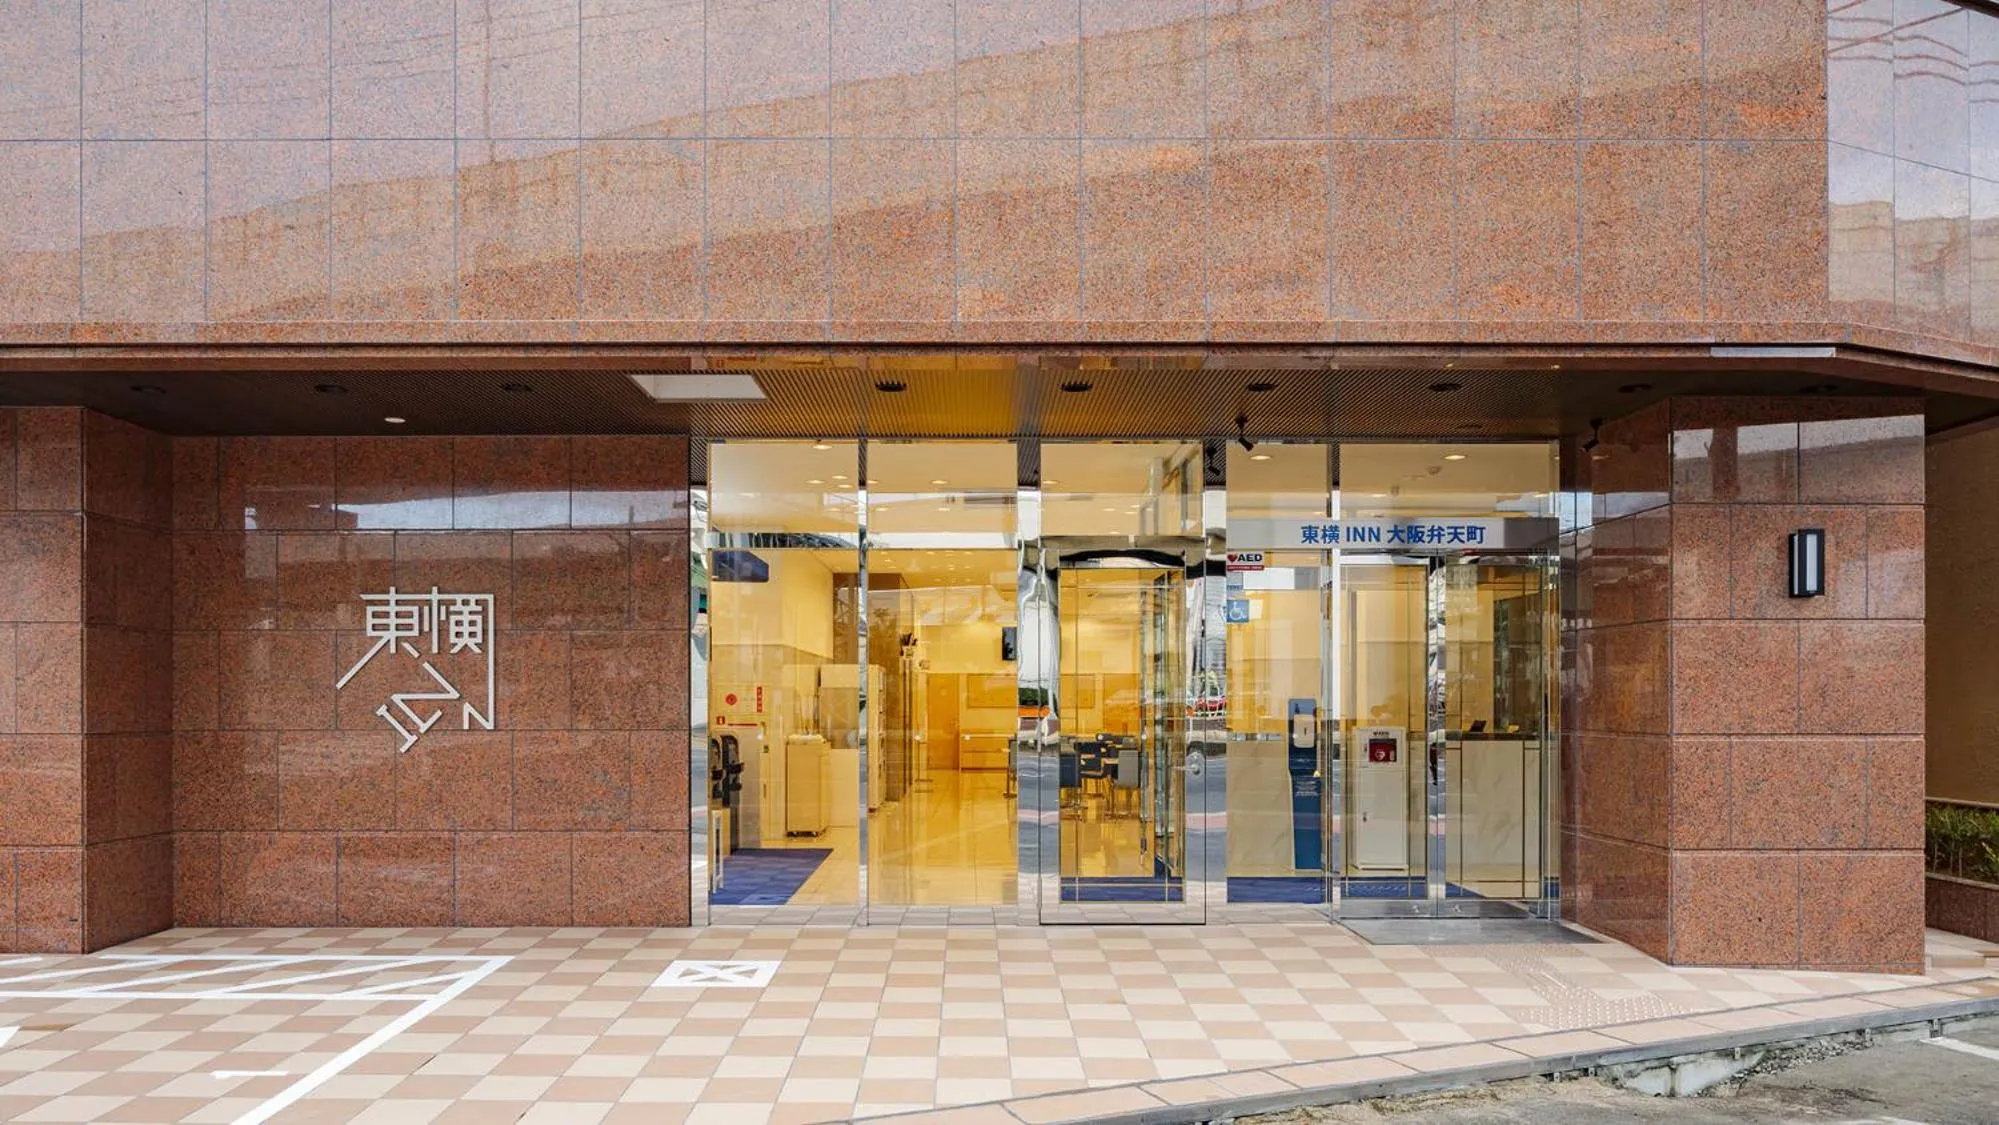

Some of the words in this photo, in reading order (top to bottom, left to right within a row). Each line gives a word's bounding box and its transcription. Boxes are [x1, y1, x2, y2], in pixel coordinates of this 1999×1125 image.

[1300, 525, 1340, 544] 東横
[1346, 526, 1381, 542] INN
[1387, 525, 1486, 544] 大阪弁天町
[1238, 554, 1263, 562] AED
